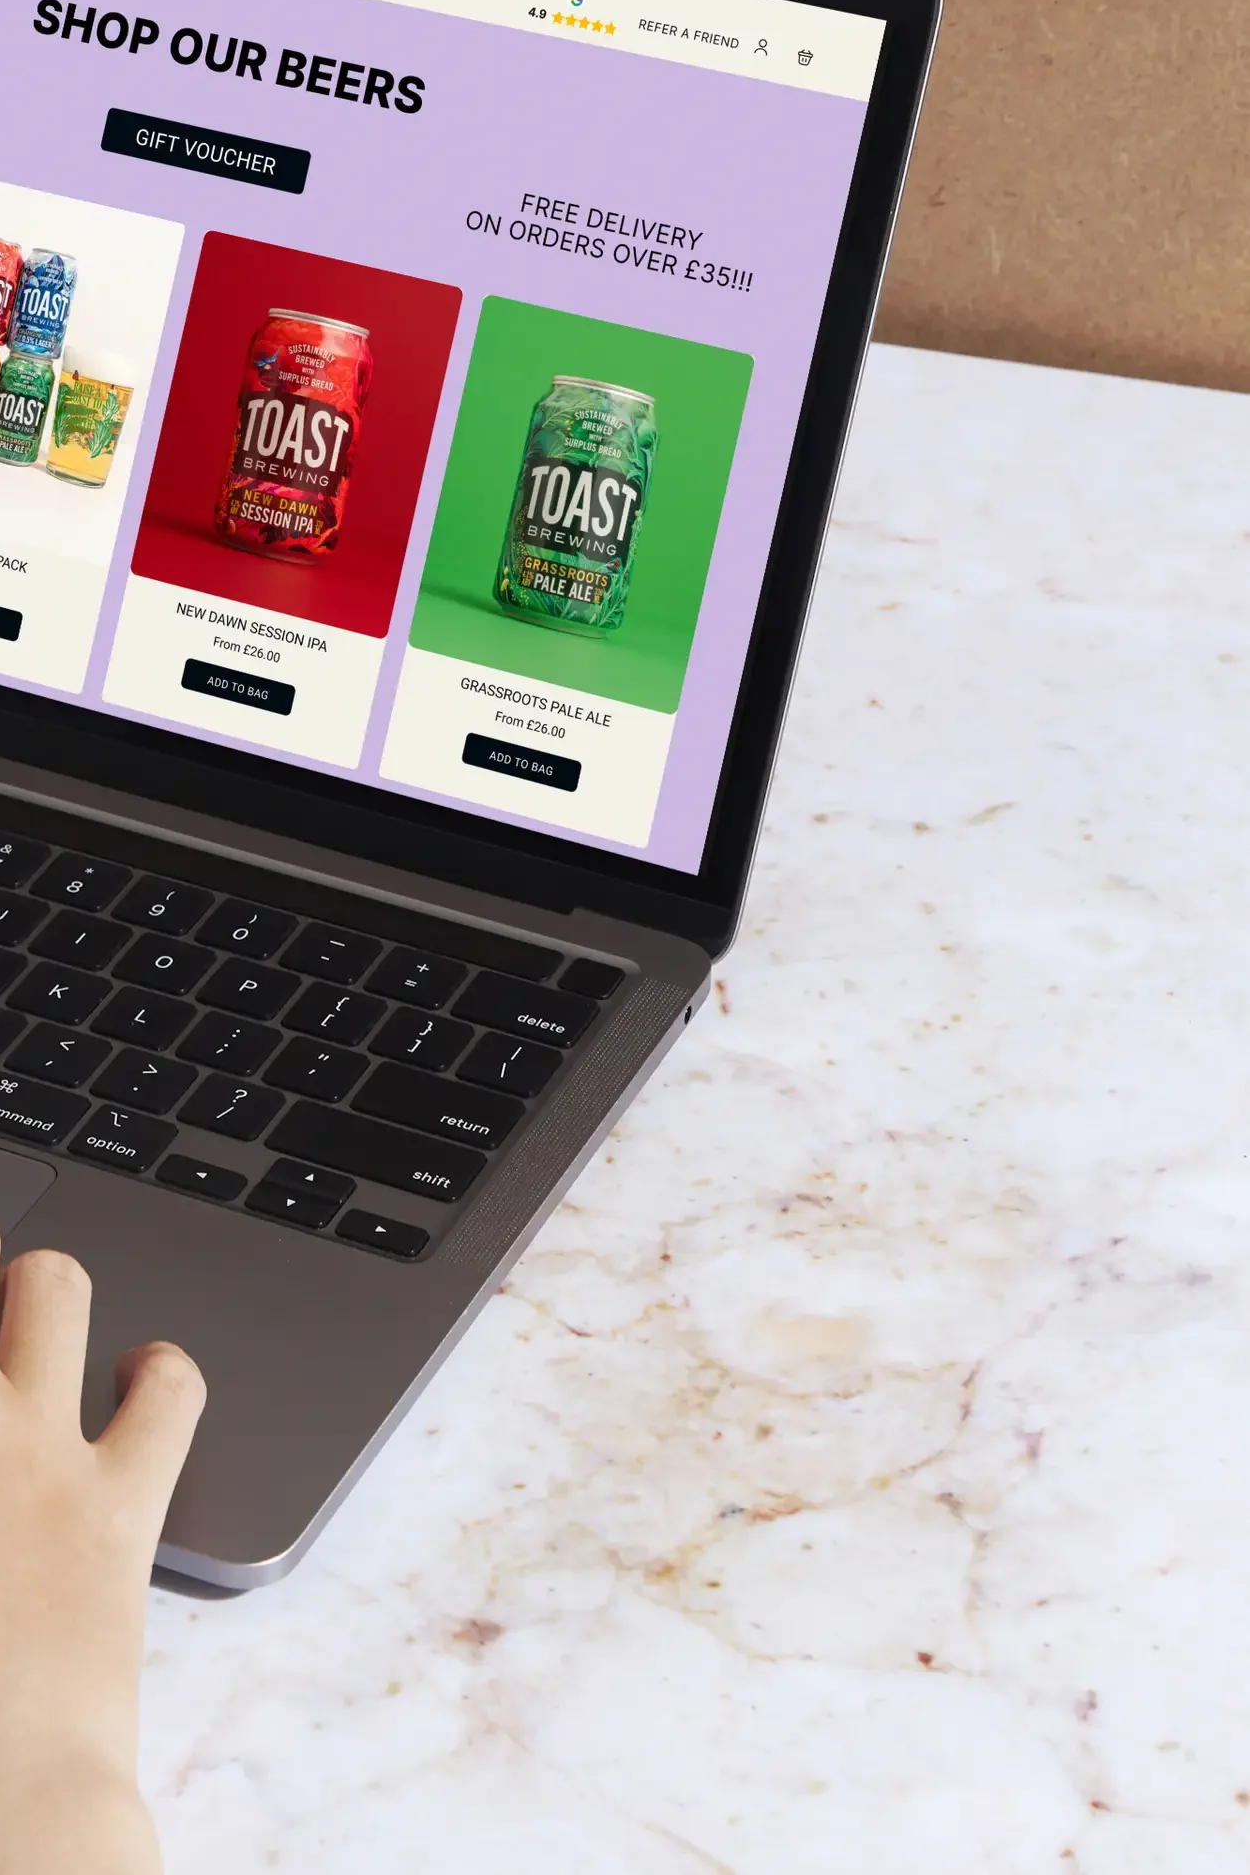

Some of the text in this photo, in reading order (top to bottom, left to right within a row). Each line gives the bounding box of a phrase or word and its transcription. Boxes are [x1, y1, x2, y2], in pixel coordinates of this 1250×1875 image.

[527, 5, 548, 21] 4.9
[638, 18, 740, 50] REFER A FRIEND
[169, 27, 268, 81] OUR
[275, 48, 426, 115] BEERS
[135, 128, 277, 176] GIFT VOUCHER
[519, 193, 704, 251] FREE DELIVERY
[465, 210, 753, 293] ON ORDERS OVER £35!!!
[21, 288, 69, 322] TOAST
[21, 314, 60, 329] BREWING
[287, 343, 337, 363] SUSTAINABLY
[295, 354, 325, 369] BREWED
[278, 371, 334, 391] SURPLUS BREAD
[574, 410, 625, 430] SUSTAINABLY
[581, 420, 613, 436] BREWED
[0, 440, 25, 454] PALE ALE
[243, 398, 350, 473] TOAST
[564, 437, 622, 458] SURPLUS BREAD
[243, 457, 330, 487] BREWING
[243, 489, 318, 516] NEW DAWN
[526, 465, 638, 542] TOAST
[240, 502, 292, 529] SESSION
[294, 515, 314, 534] IPA
[527, 524, 618, 556] BREWING
[524, 556, 609, 587] GRASSROOTS
[533, 573, 567, 596] PALE
[568, 582, 594, 602] ALE
[176, 602, 328, 653] NEW DAWN SESSION IPA
[213, 636, 281, 664] From £26.00
[206, 675, 269, 701] ADD TO BAG
[460, 677, 612, 727] GRASSROOTS PALE ALE
[494, 710, 566, 739] From £26.00
[488, 751, 554, 776] ADD TO BAG
[66, 880, 84, 893] 8
[148, 904, 165, 917] 9
[154, 955, 173, 969] O
[49, 984, 69, 999] K
[239, 979, 258, 991] P
[134, 1009, 146, 1024] L
[517, 1012, 565, 1034] delete
[440, 1113, 490, 1136] return
[86, 1135, 137, 1157] option
[412, 1169, 451, 1189] shift
